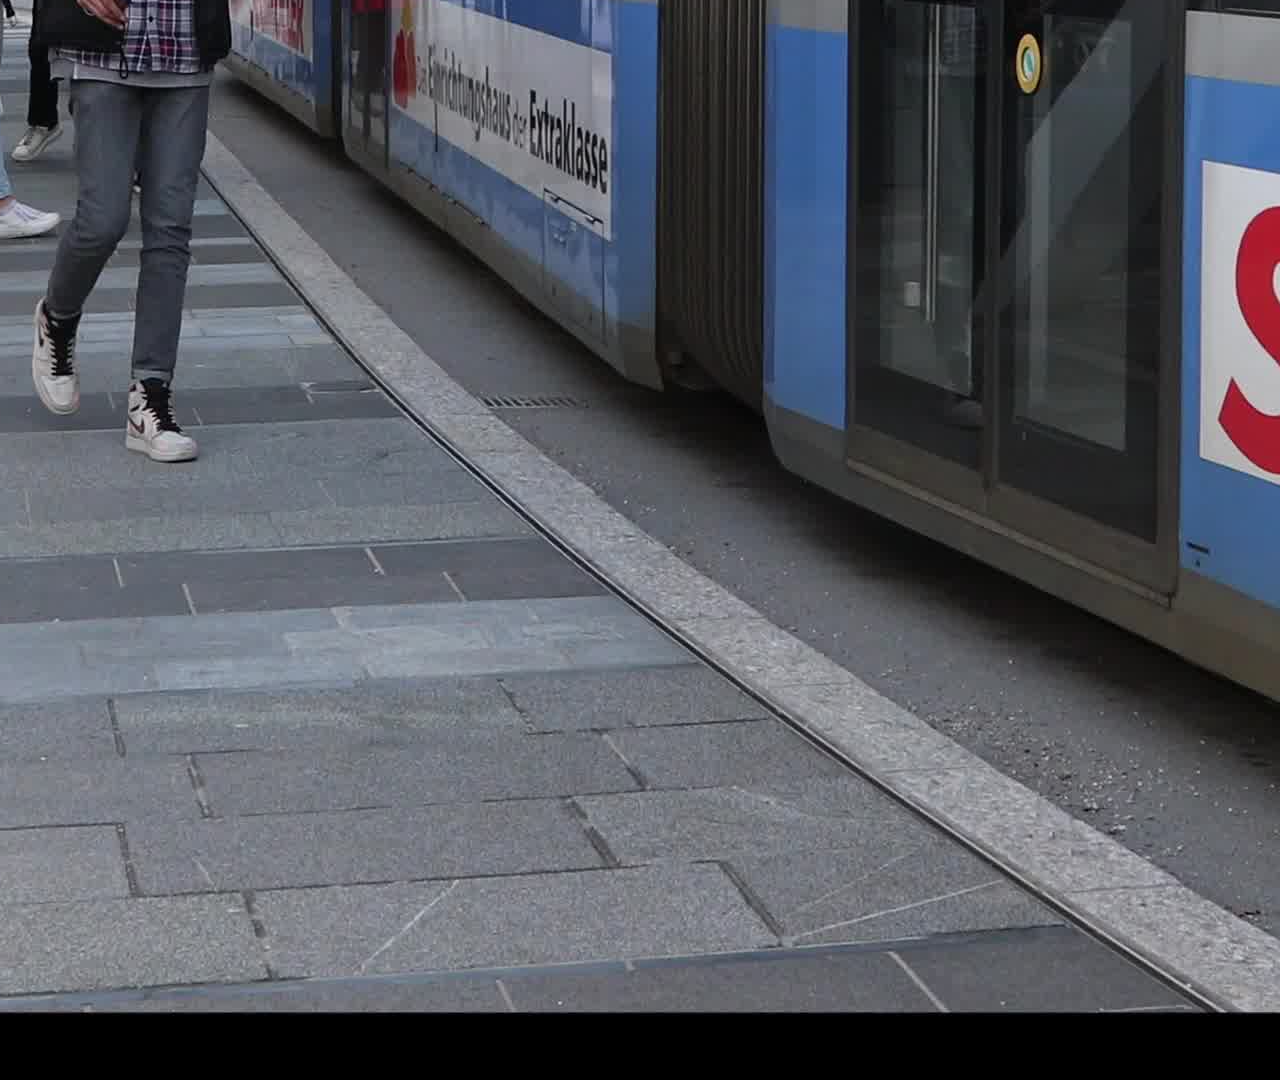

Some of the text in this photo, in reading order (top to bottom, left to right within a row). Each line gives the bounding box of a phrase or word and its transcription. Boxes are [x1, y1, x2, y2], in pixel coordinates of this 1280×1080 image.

[428, 41, 511, 142] Einrichtungshaus
[513, 99, 527, 150] der
[529, 89, 608, 194] Extraklasse
